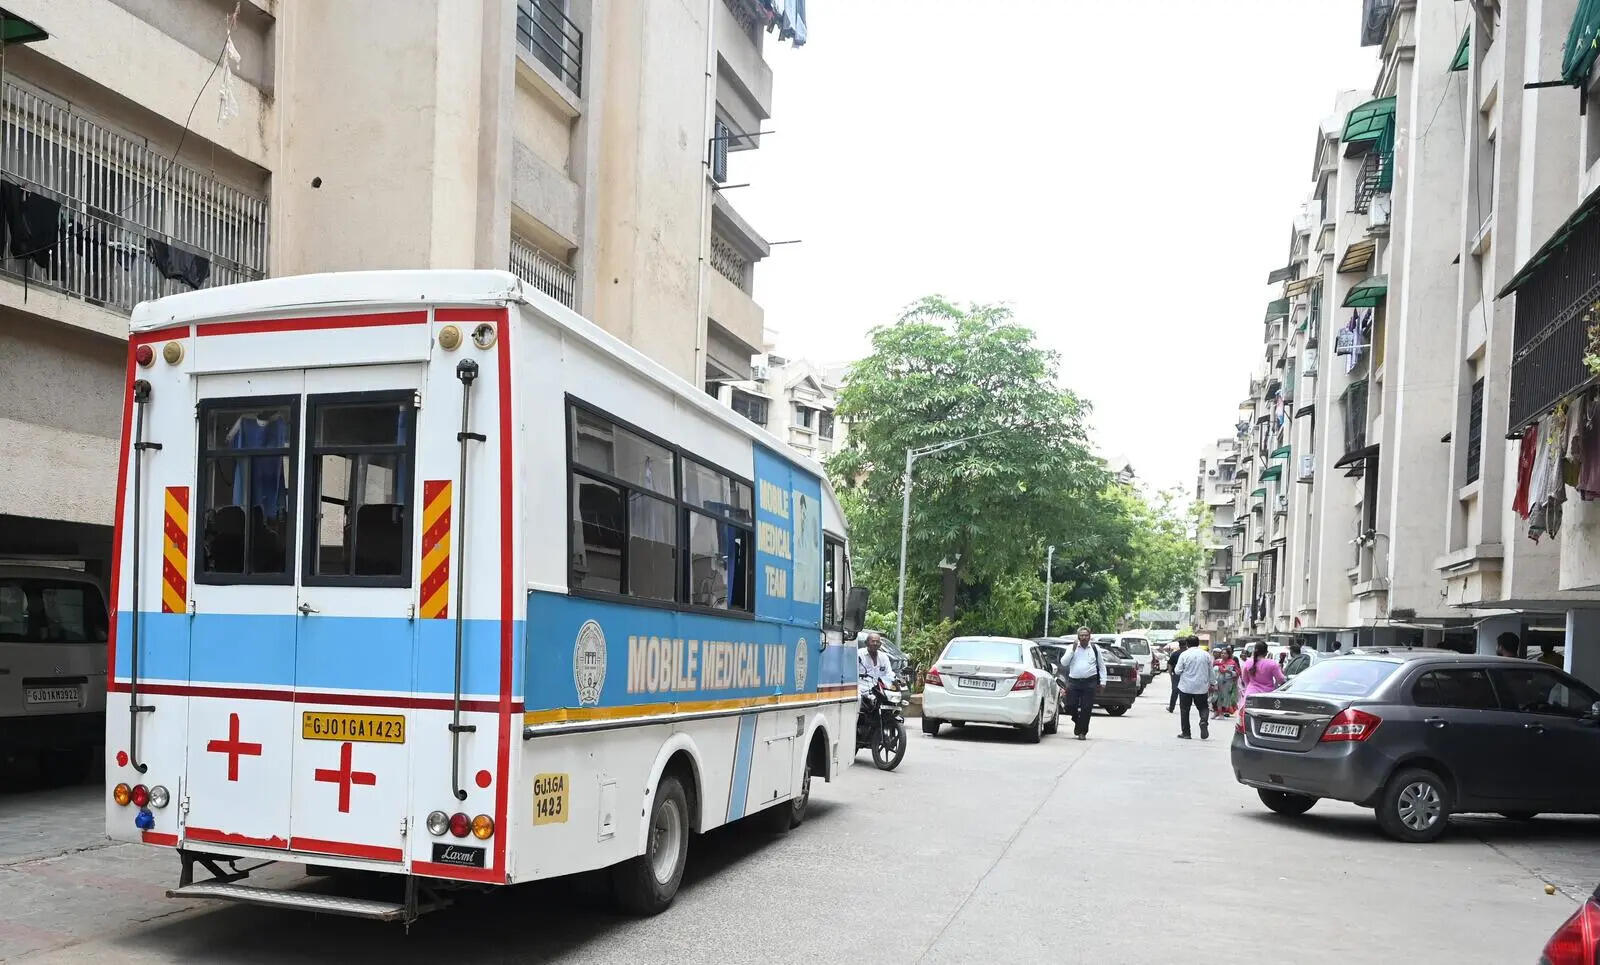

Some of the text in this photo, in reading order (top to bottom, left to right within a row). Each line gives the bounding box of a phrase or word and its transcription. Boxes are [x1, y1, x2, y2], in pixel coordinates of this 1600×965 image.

[759, 478, 789, 519] MOBILE
[757, 520, 791, 561] MEDICAL
[765, 565, 787, 599] TEAM
[627, 635, 699, 693] MOBILE
[701, 640, 760, 690] MEDICAL
[764, 643, 787, 686] VAN
[32, 689, 78, 701] GJ01KM3922
[313, 718, 402, 738] GJ01GA1423
[537, 796, 562, 818] 1423
[441, 845, 477, 862] Laxmi
